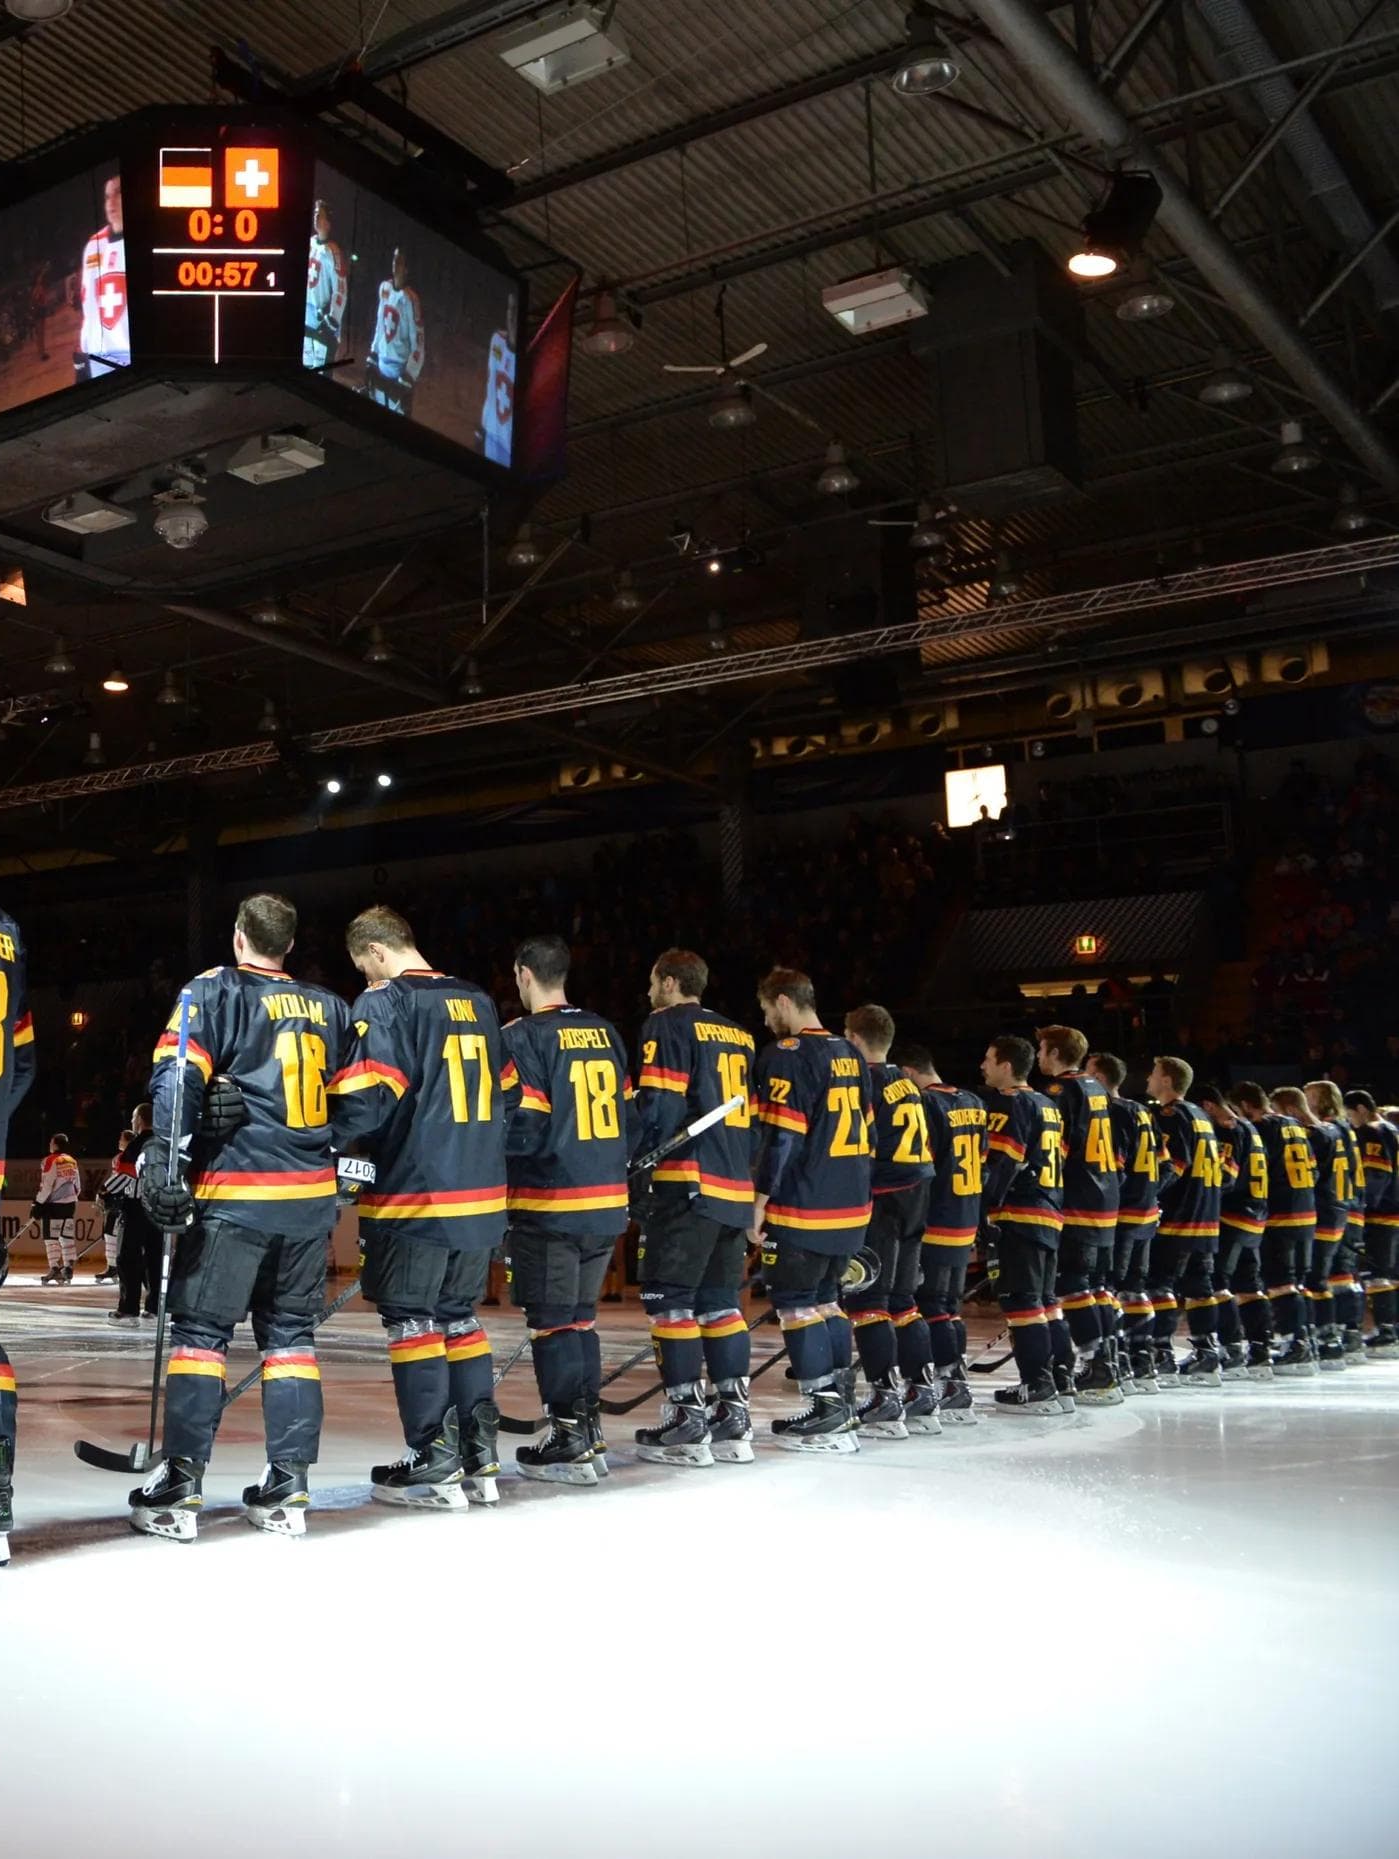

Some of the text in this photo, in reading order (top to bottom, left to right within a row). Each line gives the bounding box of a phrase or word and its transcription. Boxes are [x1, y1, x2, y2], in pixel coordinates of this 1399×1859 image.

[178, 261, 277, 288] 00:57 1
[441, 1033, 494, 1124] 17
[569, 1058, 620, 1141] 18
